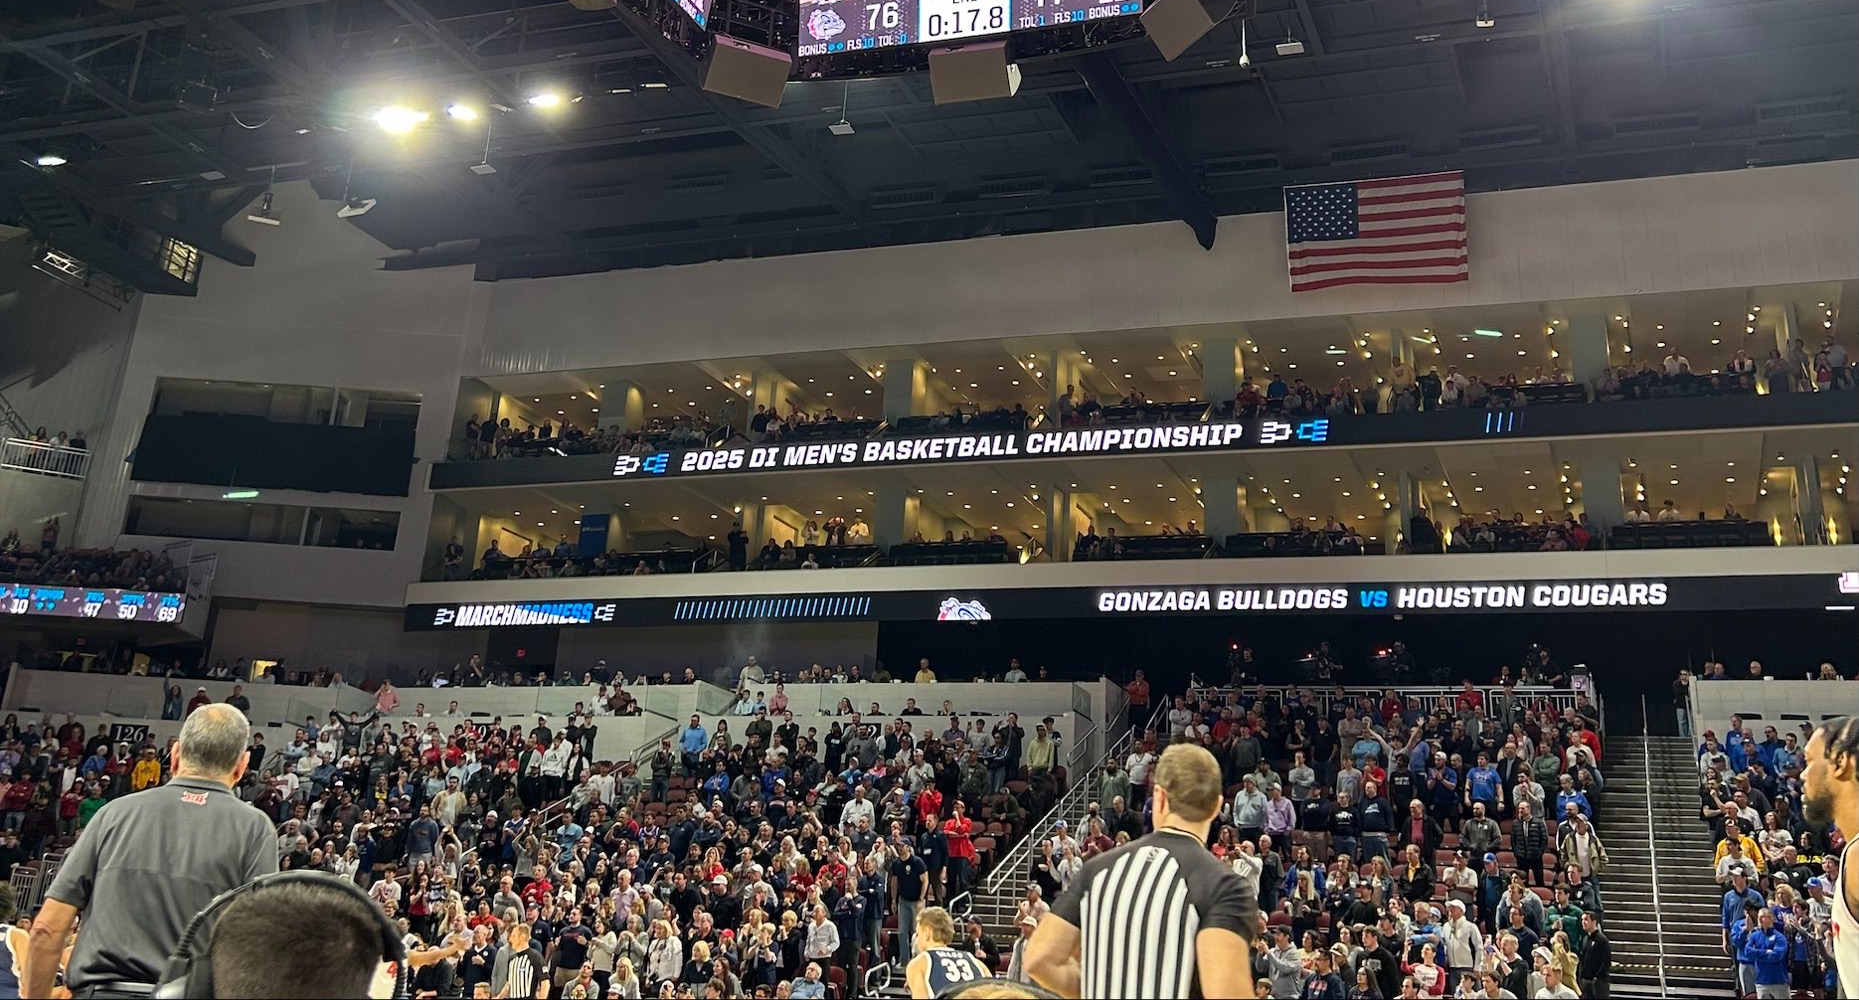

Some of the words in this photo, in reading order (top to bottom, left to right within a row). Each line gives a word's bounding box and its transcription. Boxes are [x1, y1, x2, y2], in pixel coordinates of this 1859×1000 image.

[865, 1, 899, 31] 76
[928, 6, 1003, 37] 0:17.8
[1019, 15, 1036, 29] TOL
[1039, 15, 1046, 26] 1
[1054, 11, 1071, 25] FLS
[1071, 10, 1085, 22] 10
[1088, 4, 1121, 20] BONUS
[798, 43, 827, 57] BONUS
[847, 38, 862, 51] FLS
[862, 37, 875, 49] 10
[878, 34, 894, 48] TOL
[681, 449, 745, 472] 2025
[749, 447, 780, 468] DI
[783, 442, 858, 467] MEN'S
[863, 433, 1019, 462] BASKETBALL
[1026, 423, 1243, 454] CHAMPIONSHIP
[1099, 590, 1211, 612] GONZAGA
[1217, 588, 1349, 610] BULLDOGS
[1360, 590, 1388, 608] VS
[1397, 585, 1526, 609] HOUSTON
[1532, 583, 1668, 608] COUGARS
[10, 599, 30, 615] 10
[84, 602, 102, 618] 47
[117, 604, 138, 619] 50
[157, 606, 178, 623] 69
[114, 726, 145, 742] 126
[940, 958, 975, 983] 33
